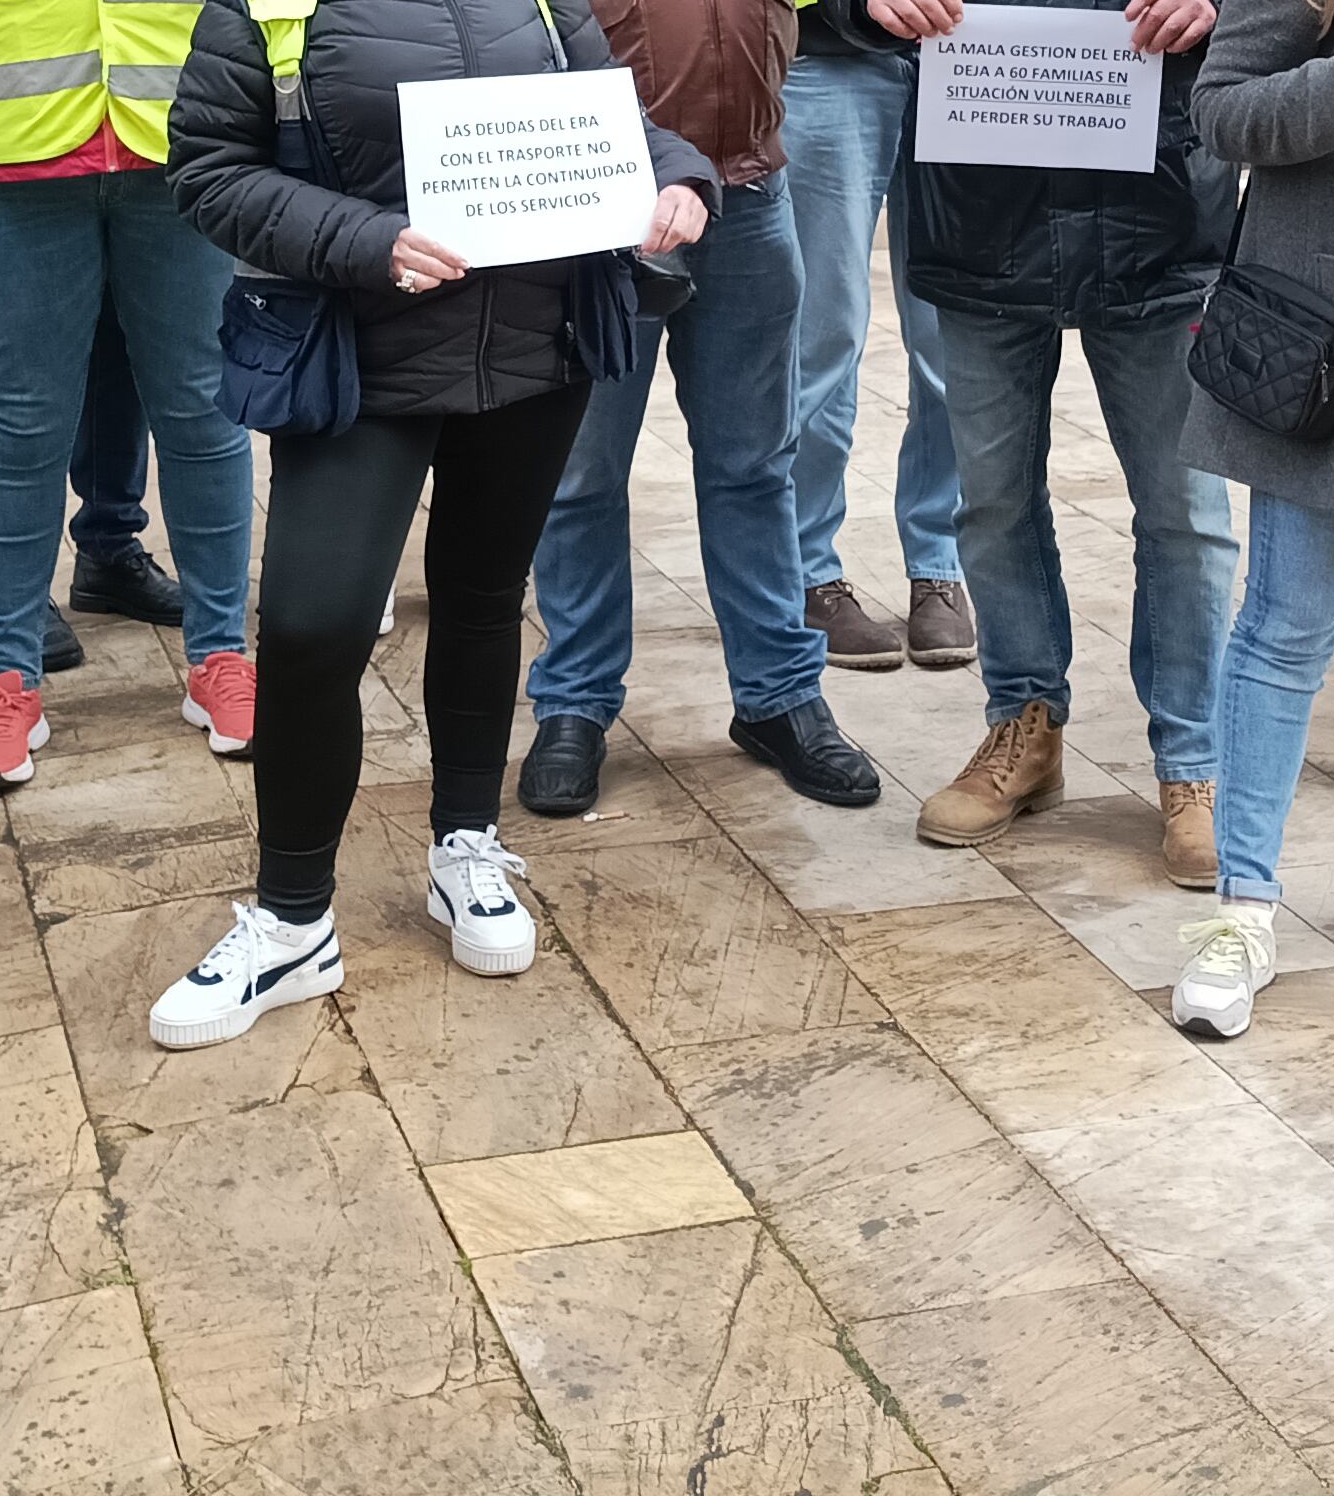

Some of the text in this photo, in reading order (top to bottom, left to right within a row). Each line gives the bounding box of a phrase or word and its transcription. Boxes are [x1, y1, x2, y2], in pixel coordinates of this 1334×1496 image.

[938, 41, 1147, 64] LA MALA GESTION DEL ERA,
[953, 64, 1129, 84] DEJA A 60 FAMILIAS EN
[946, 85, 1132, 106] SITUACIÓN VULNERABLE
[444, 115, 599, 138] LAS DEUDAS DEL ERA
[947, 110, 1127, 130] AL PERDER SU TRABAJO
[440, 140, 611, 167] CON EL TRASPORTE NO
[422, 161, 638, 195] PERMITEN LA CONTINUIDAD
[465, 191, 601, 218] DE LOS SERVICIOS
